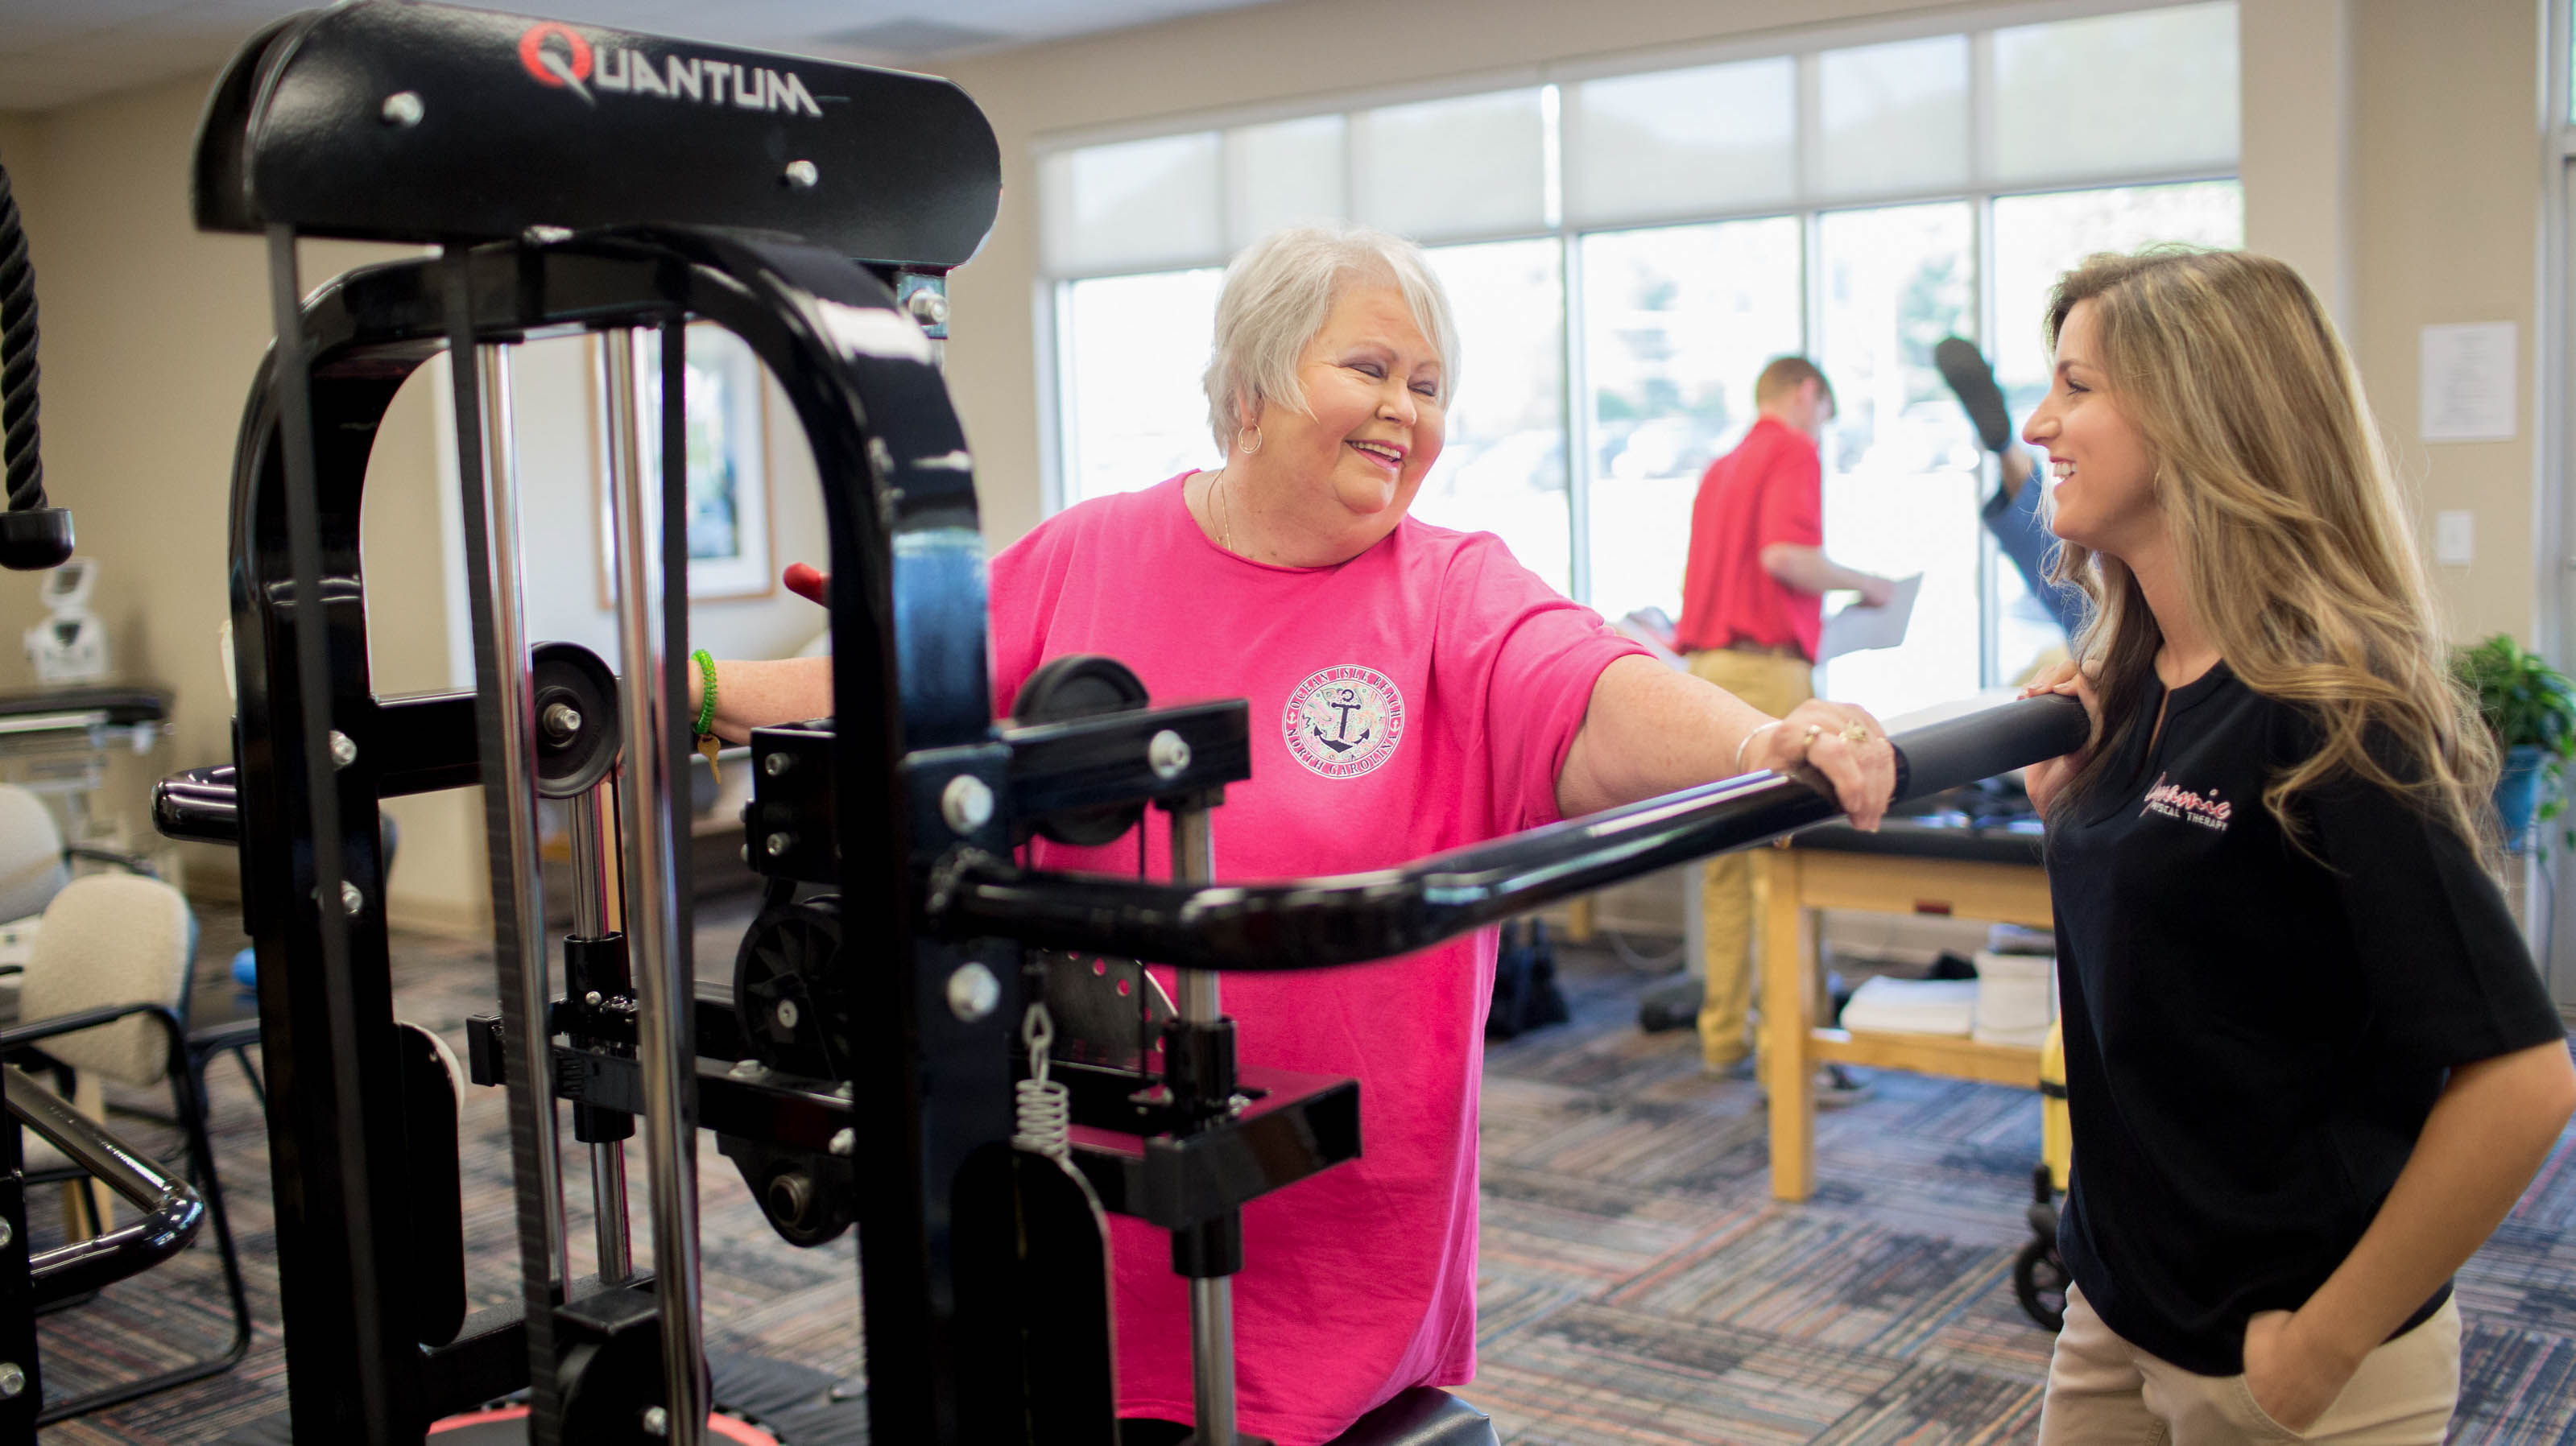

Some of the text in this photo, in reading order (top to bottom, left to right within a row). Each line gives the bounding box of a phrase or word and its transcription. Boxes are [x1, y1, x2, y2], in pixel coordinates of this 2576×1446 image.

[519, 22, 822, 117] QUANTUM
[1289, 667, 1401, 717] OCEAN ISLE BEACH
[1287, 728, 1397, 775] NORTH CAROLINA
[2185, 812, 2229, 831] THERAPY
